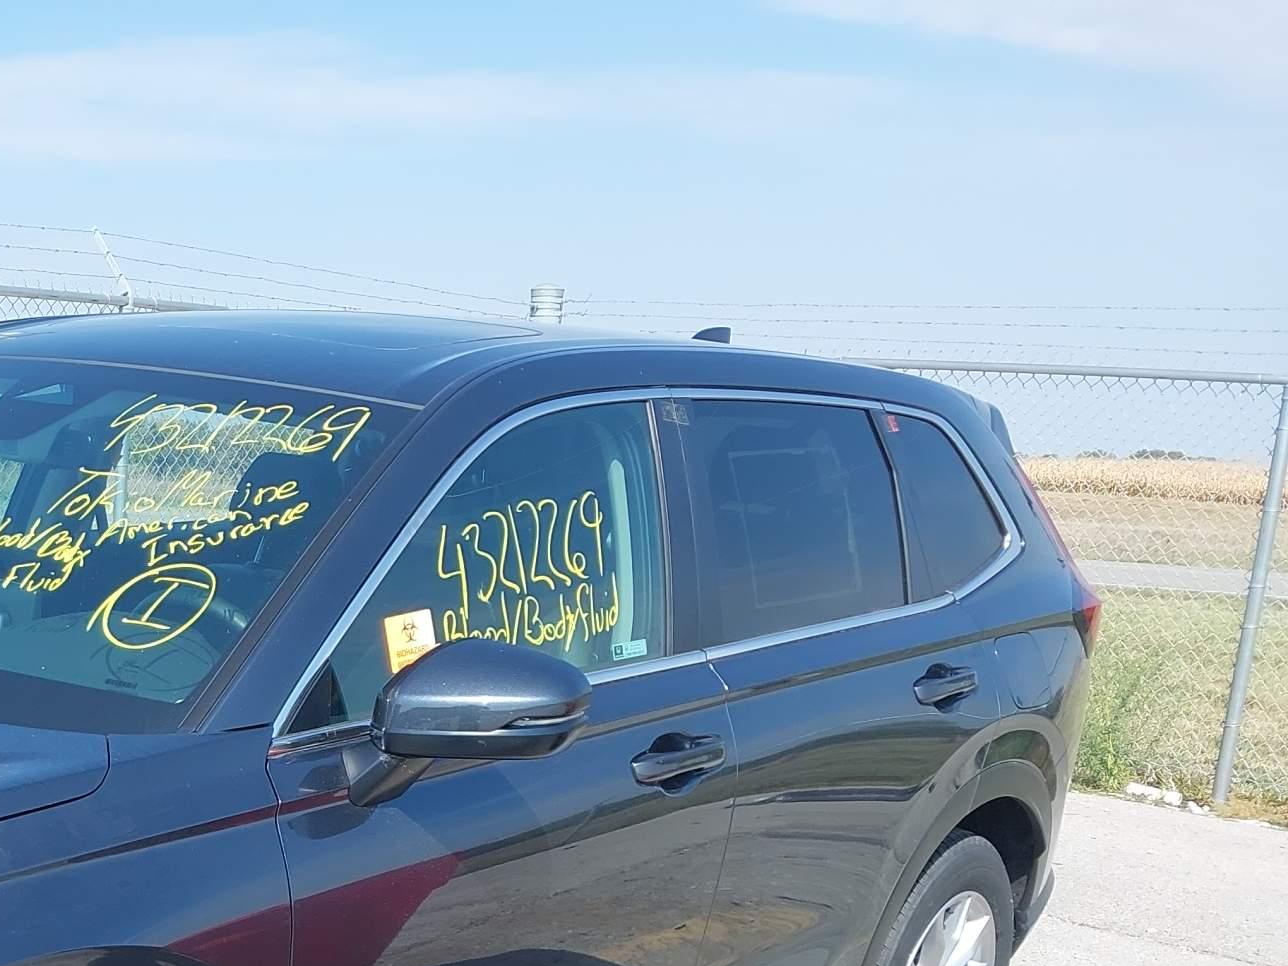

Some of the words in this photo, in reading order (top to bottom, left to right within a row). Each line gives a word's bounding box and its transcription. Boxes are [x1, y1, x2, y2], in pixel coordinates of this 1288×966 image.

[104, 394, 370, 462] 43212269
[47, 467, 155, 520] Tokio
[155, 469, 300, 508] Marine
[95, 510, 252, 546] American
[437, 490, 604, 620] 43212269
